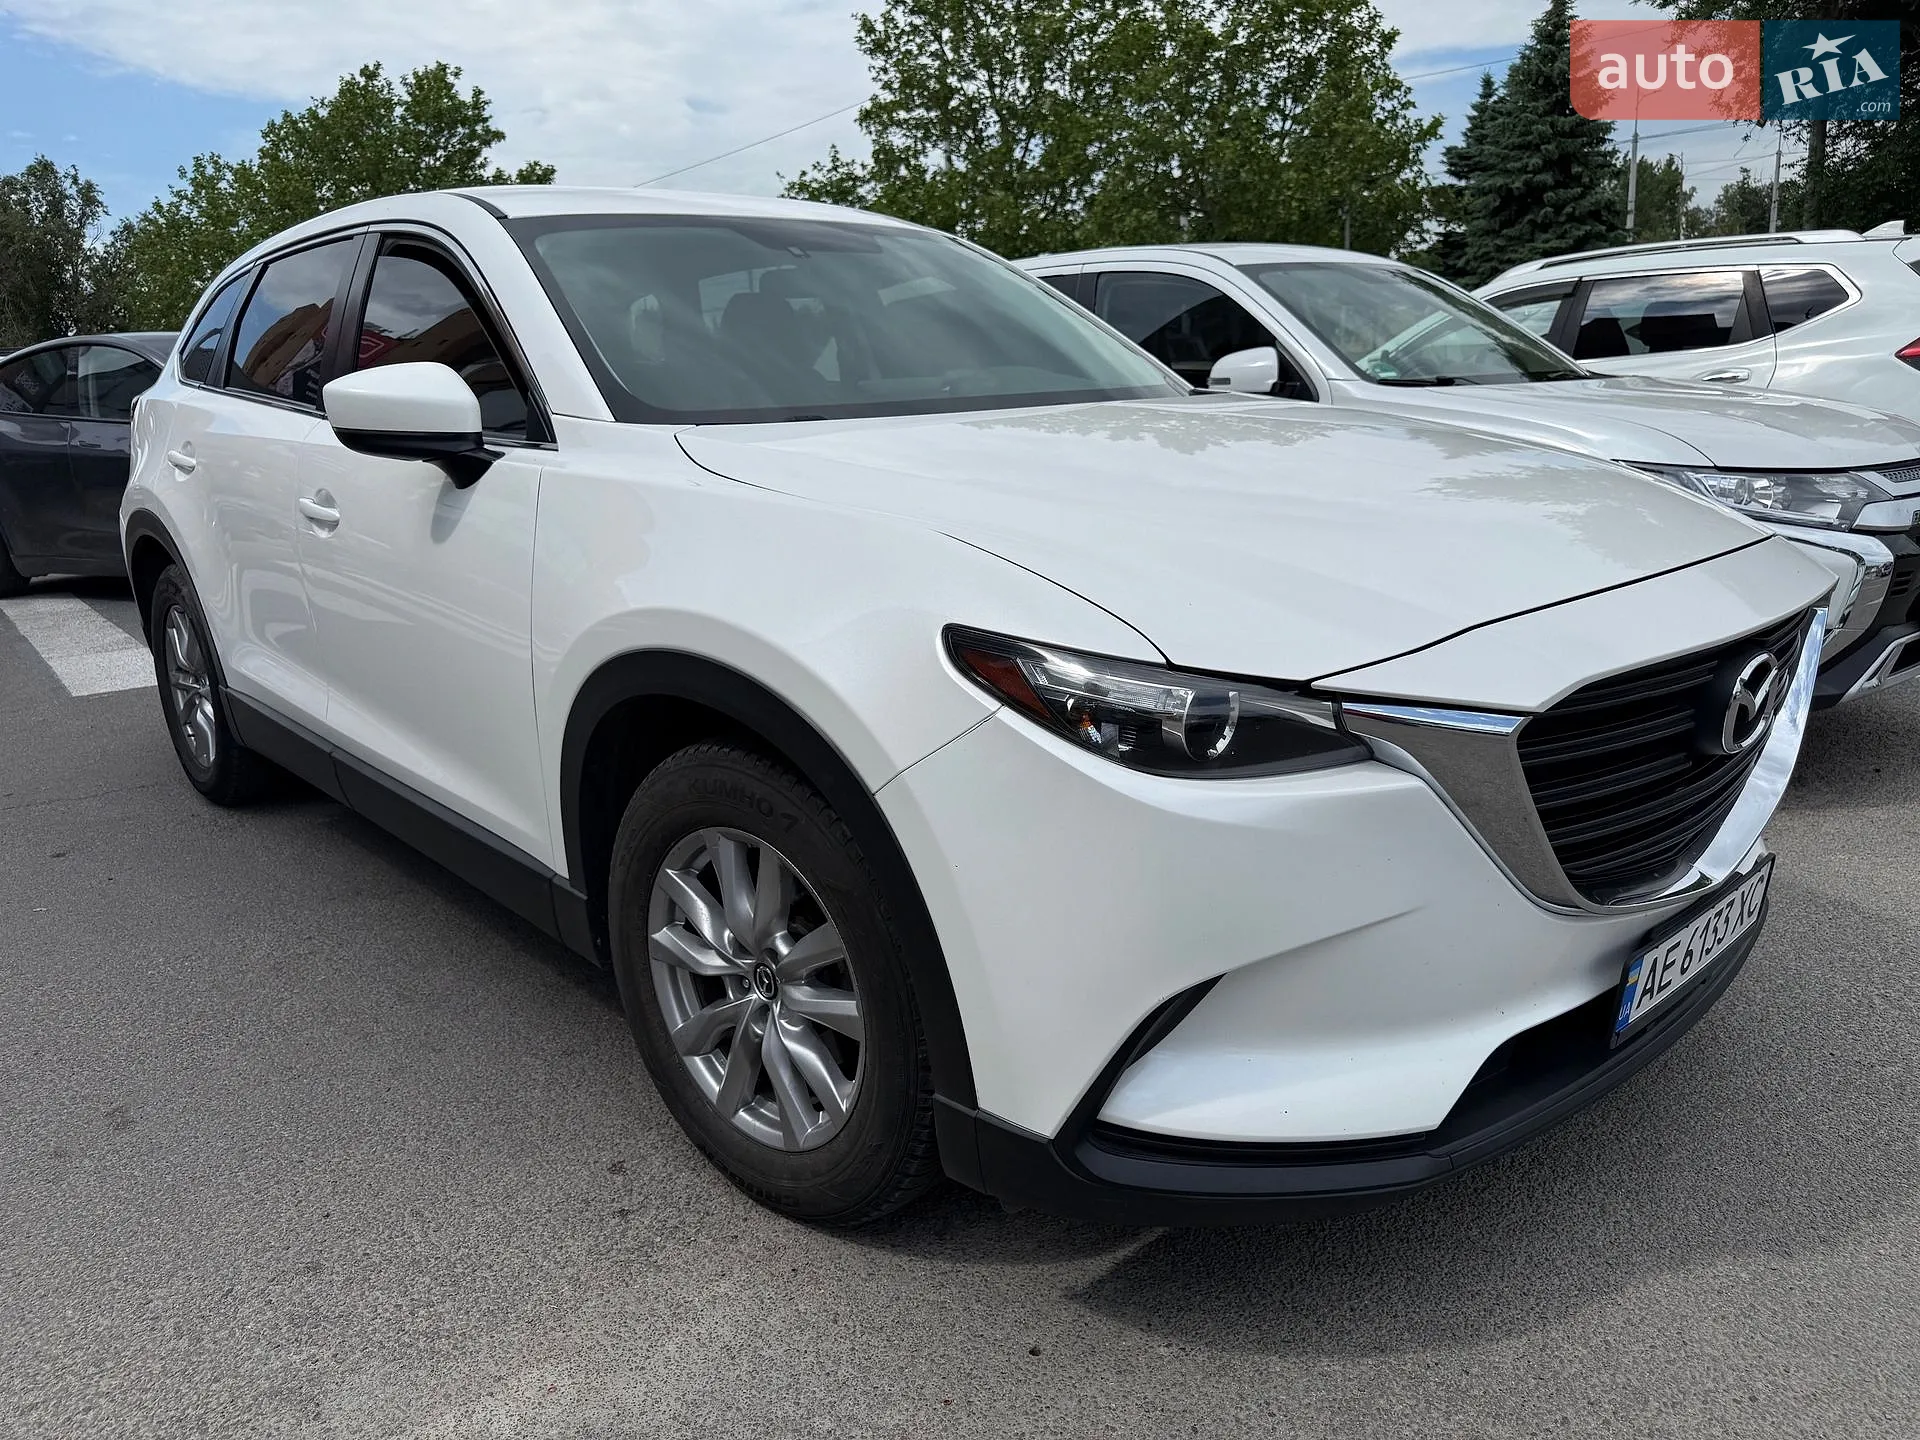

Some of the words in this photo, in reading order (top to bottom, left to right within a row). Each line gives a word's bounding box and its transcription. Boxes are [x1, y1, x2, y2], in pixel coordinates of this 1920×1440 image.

[689, 778, 774, 818] KUMHO
[1636, 939, 1681, 1010] AE
[1680, 899, 1736, 976] 6133
[1731, 874, 1764, 936] XC
[1618, 1001, 1631, 1021] UA
